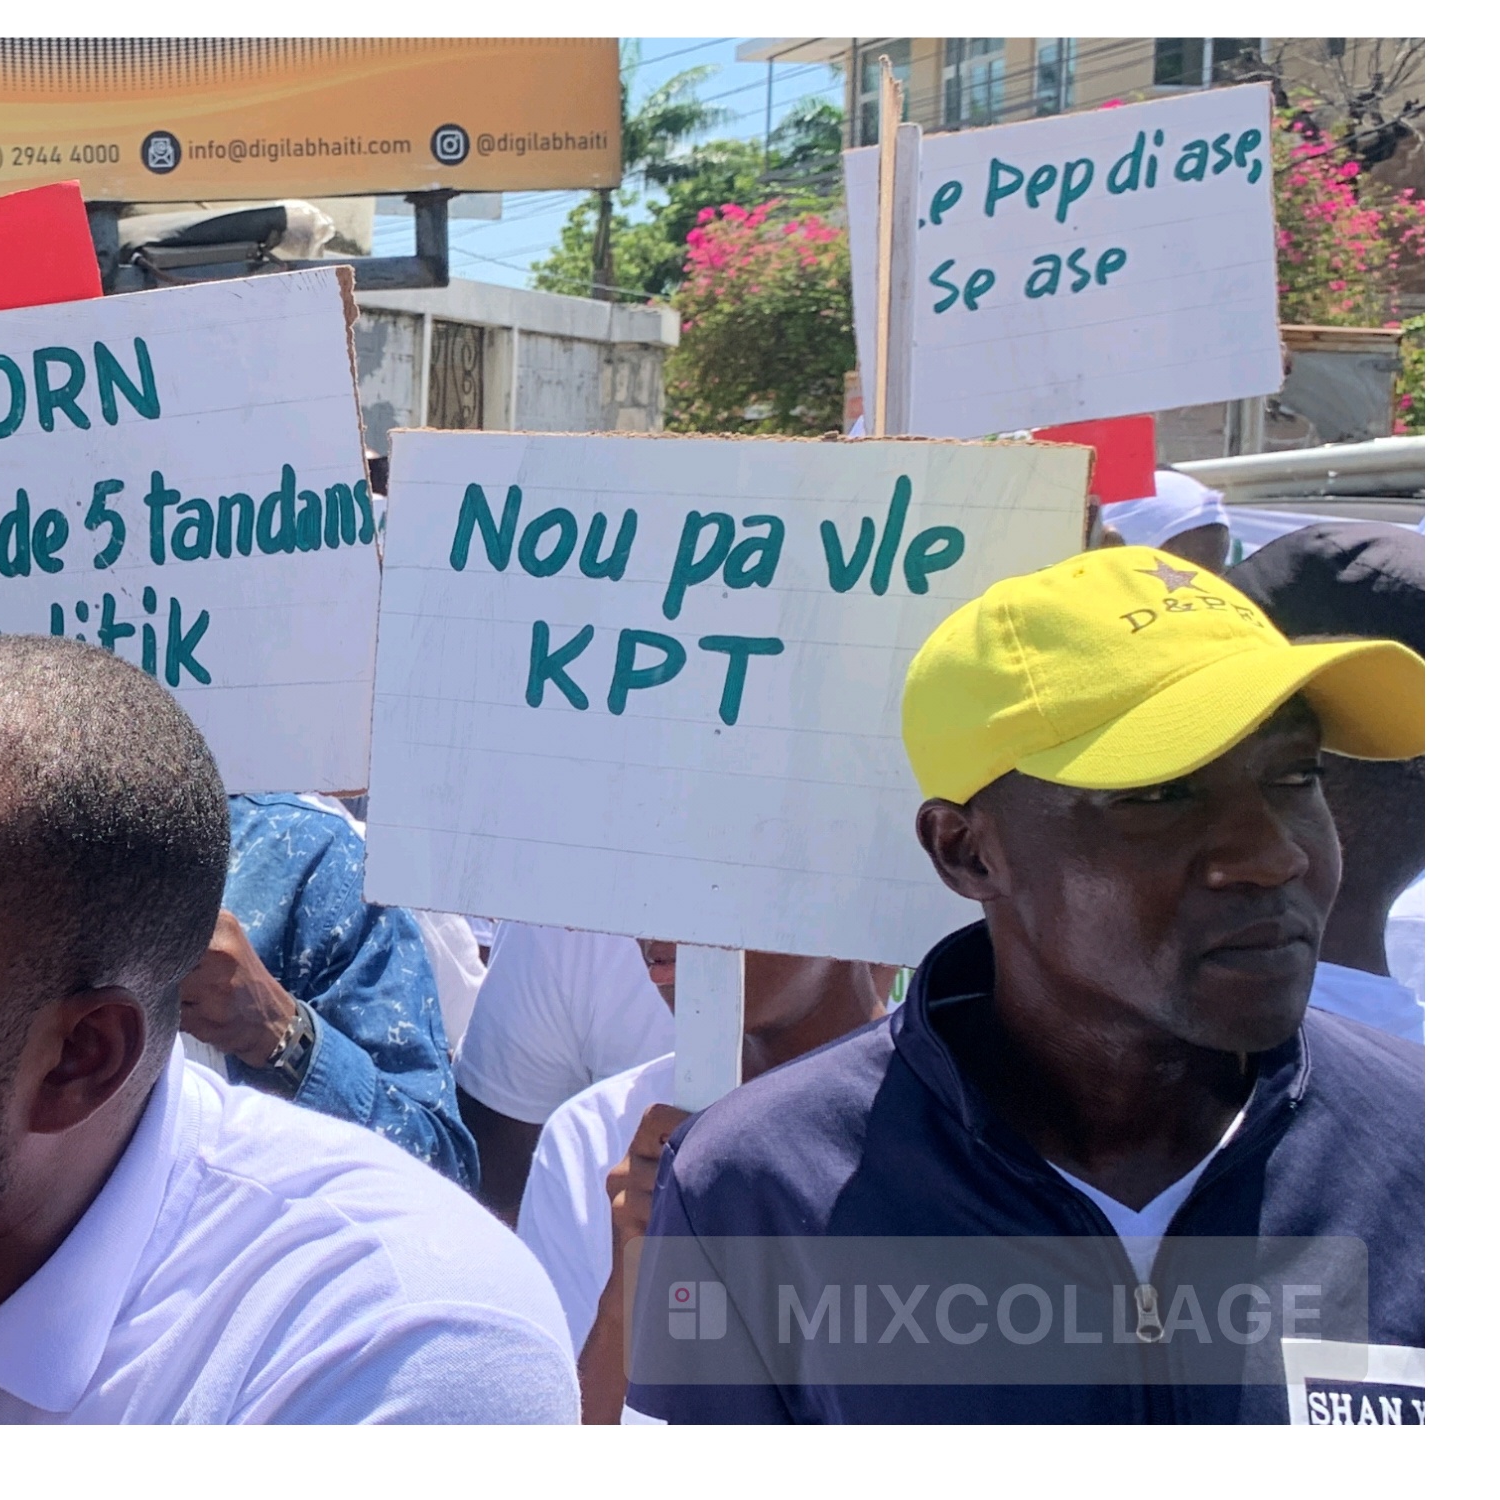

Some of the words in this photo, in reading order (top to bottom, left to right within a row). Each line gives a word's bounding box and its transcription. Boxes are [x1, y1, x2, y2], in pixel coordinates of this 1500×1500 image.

[12, 145, 62, 166] 2944
[70, 143, 120, 164] 4000
[188, 137, 411, 163] info@digilabhaiti.com
[477, 131, 607, 156] @digilabhaiti
[918, 180, 963, 228] e
[1106, 129, 1165, 195] di
[1174, 128, 1263, 185] ase,
[1025, 247, 1127, 299] ase
[84, 478, 127, 570] 5
[143, 463, 377, 566] tandans
[449, 482, 638, 582] Nou
[661, 509, 786, 621] pa
[820, 475, 965, 596] vle
[525, 619, 785, 726] KPT
[1308, 1391, 1402, 1425] SHAN
